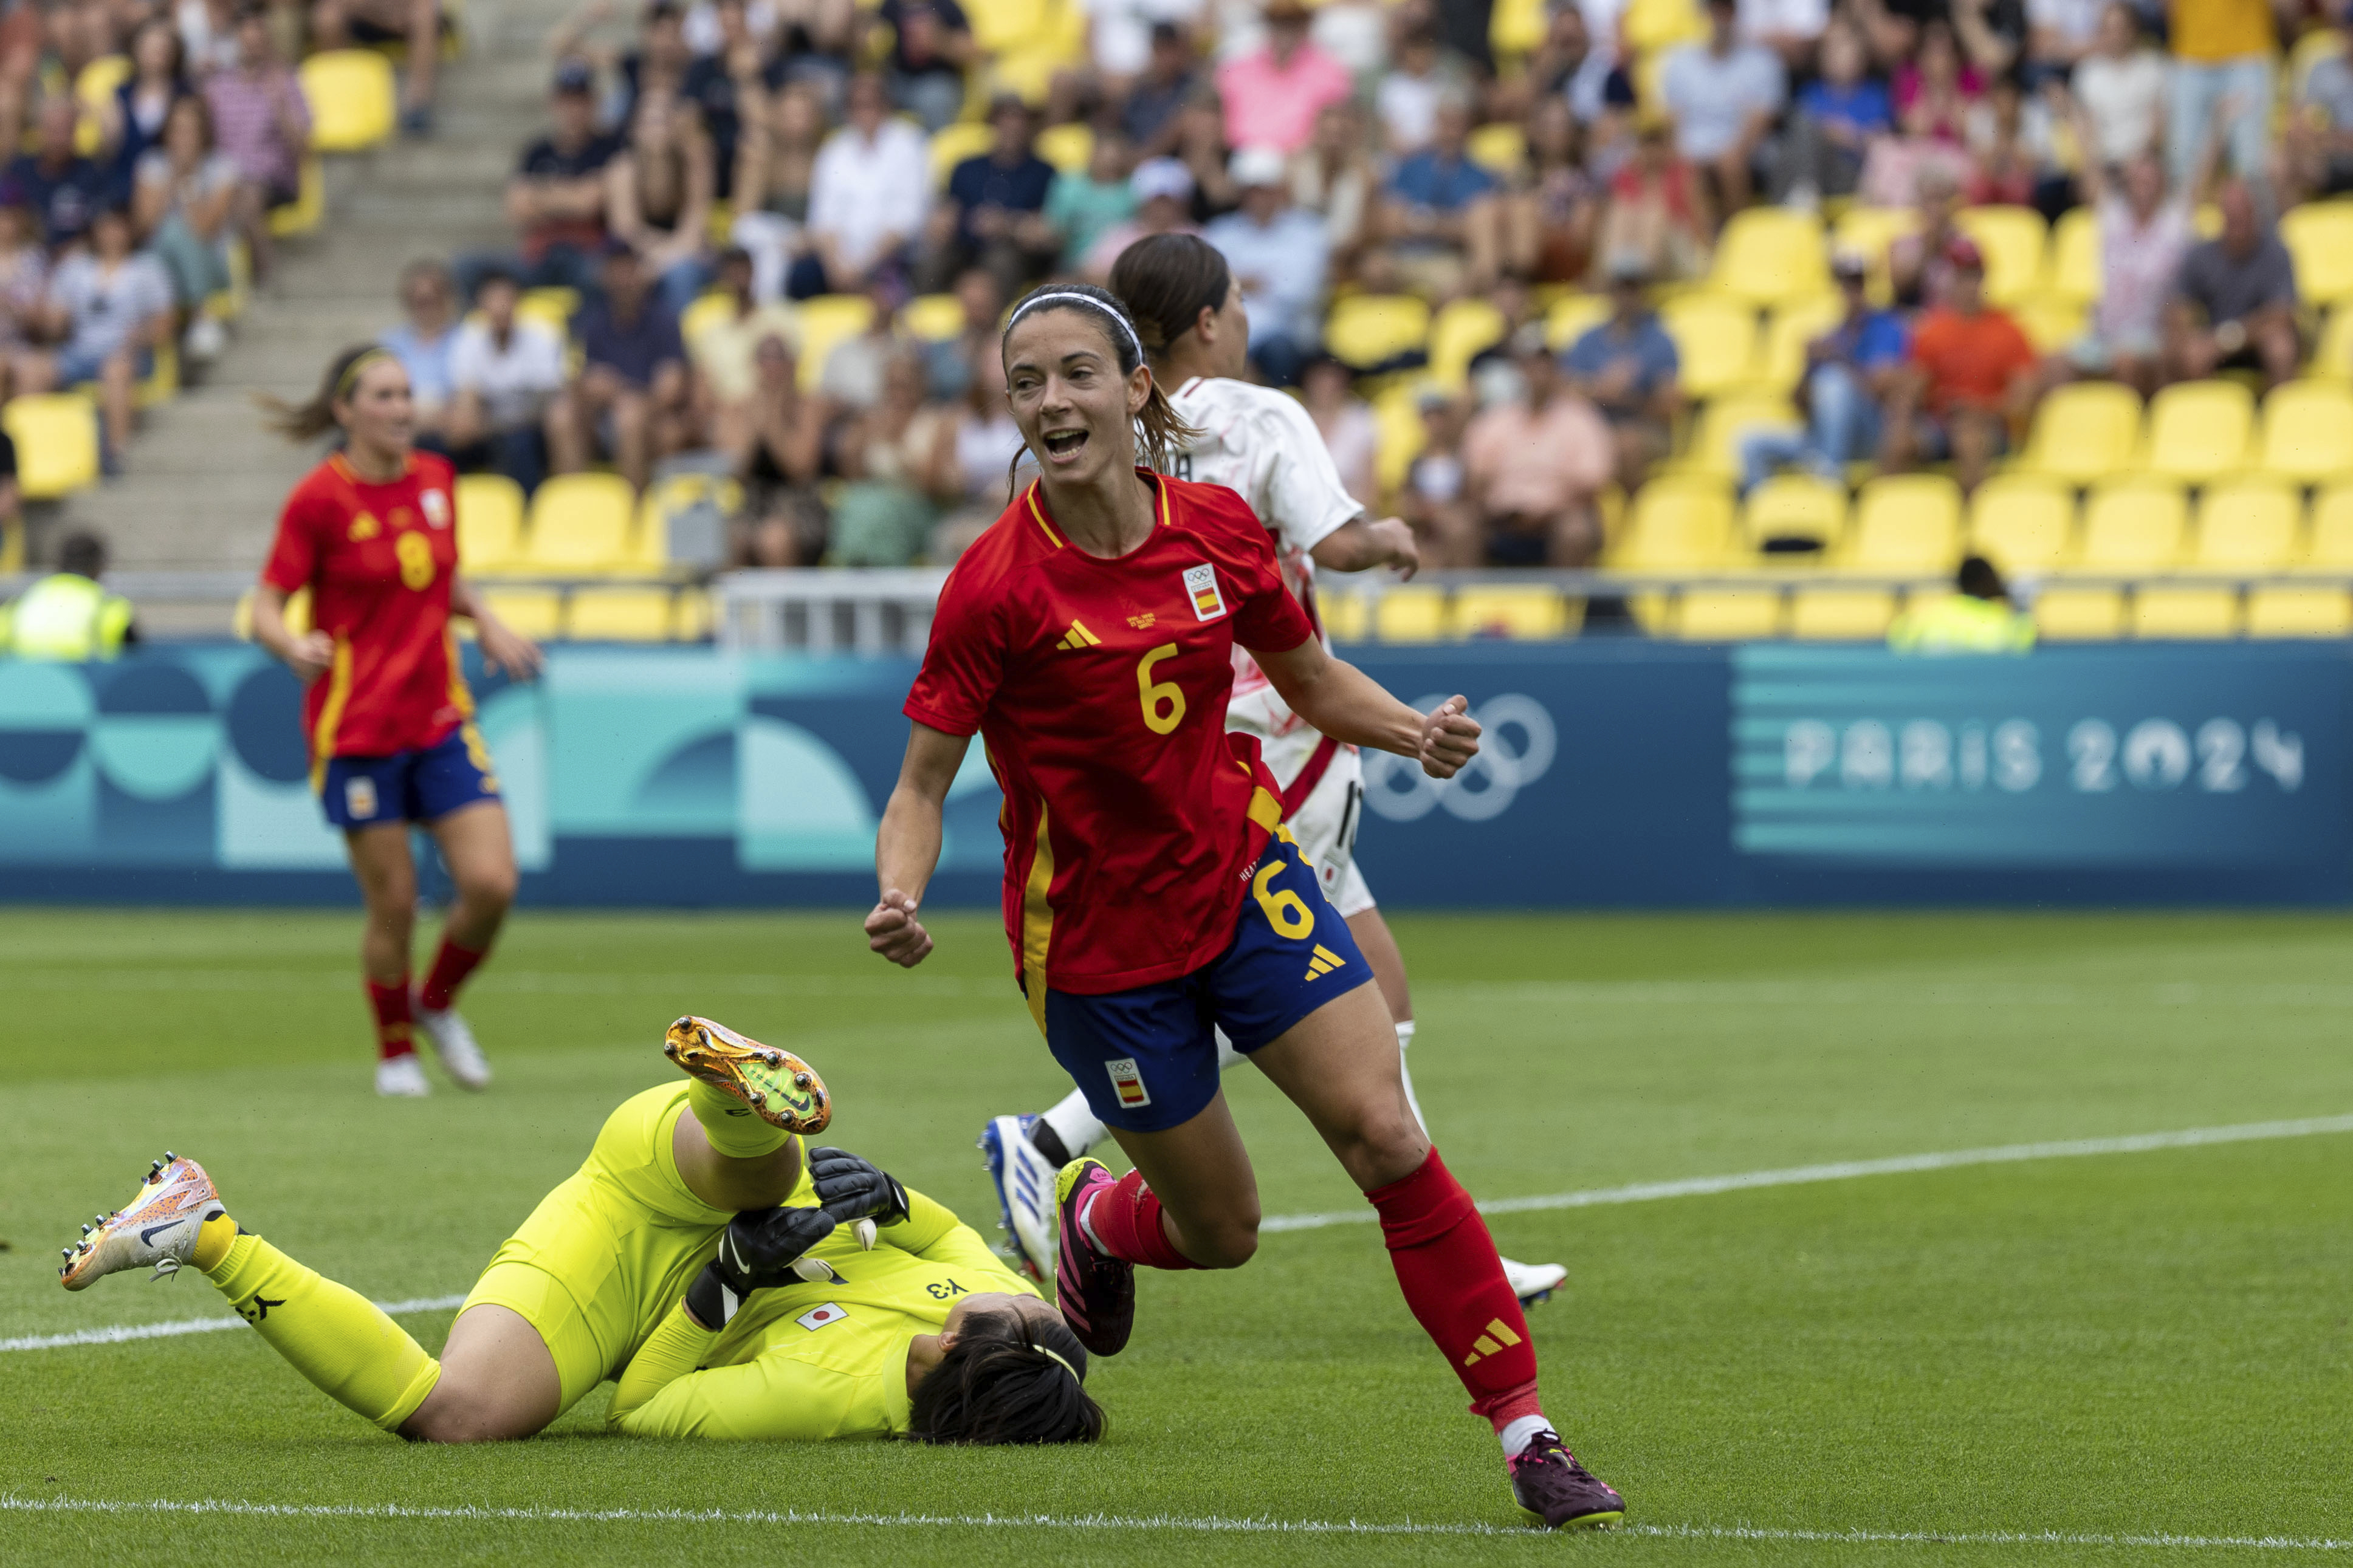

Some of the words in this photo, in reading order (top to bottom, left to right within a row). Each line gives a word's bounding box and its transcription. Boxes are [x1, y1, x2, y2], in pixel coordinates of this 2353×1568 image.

[396, 530, 437, 592] 8
[1136, 642, 1186, 735] 6
[1785, 717, 2042, 791] PARIS
[2066, 717, 2304, 792] 2024
[1239, 857, 1260, 882] HEAT
[1252, 859, 1314, 940] 6
[926, 1278, 970, 1299] Y-3
